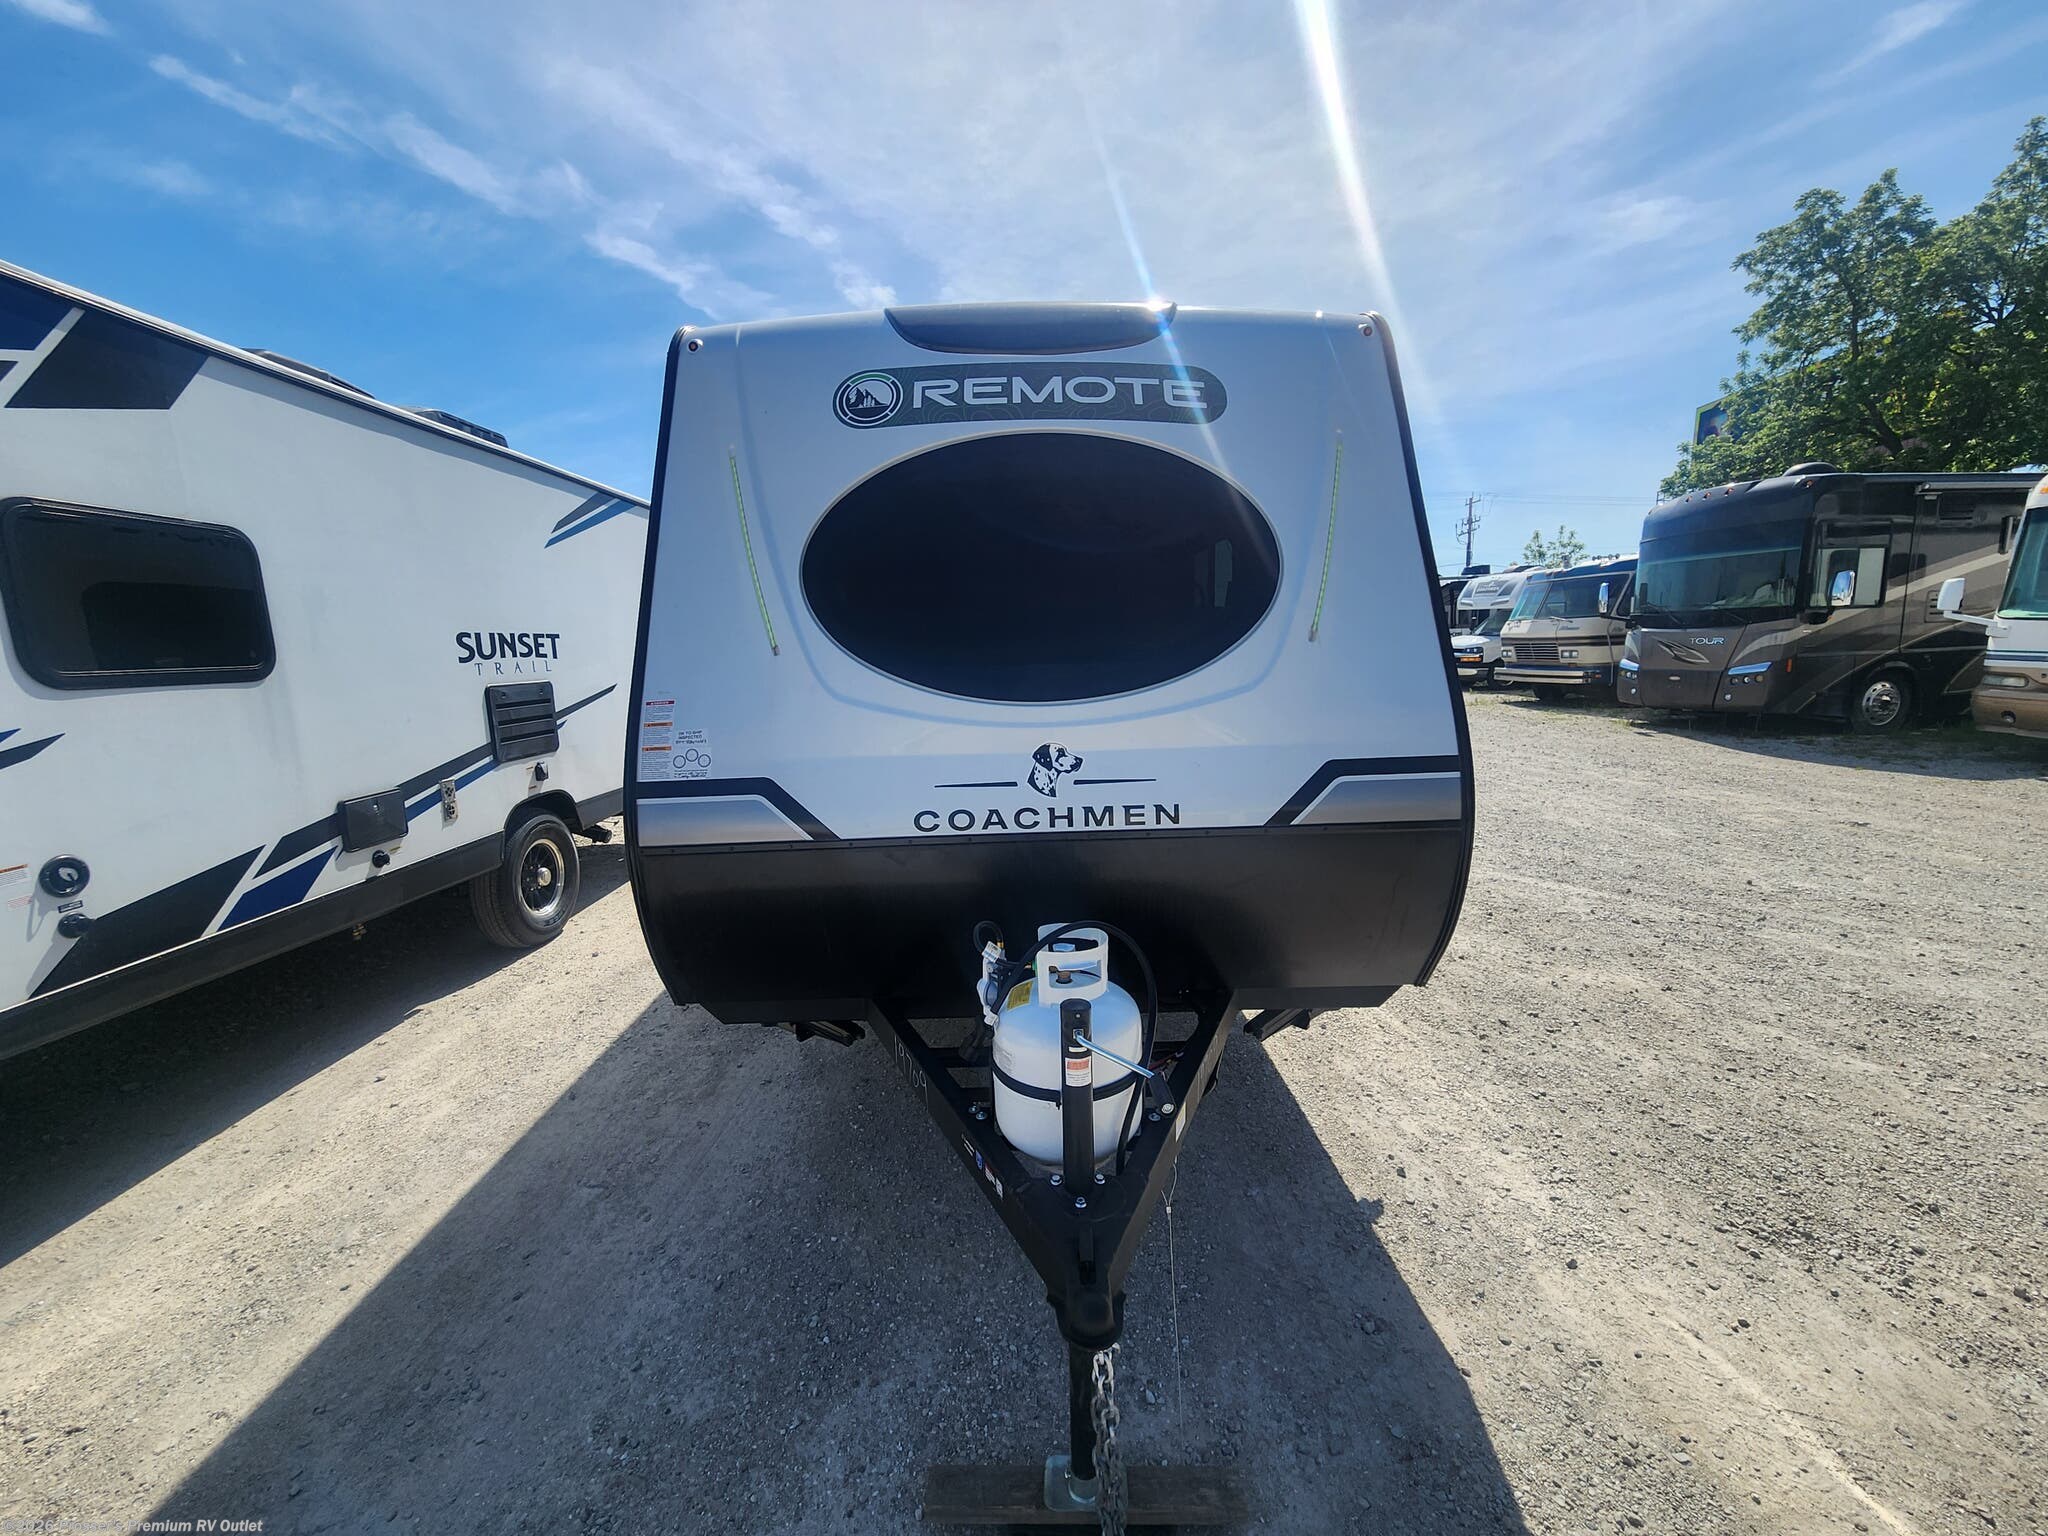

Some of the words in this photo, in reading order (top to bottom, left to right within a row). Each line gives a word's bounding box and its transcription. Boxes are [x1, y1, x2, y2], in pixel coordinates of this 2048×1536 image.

[913, 376, 1207, 409] REMOTE
[456, 631, 560, 664] SUNSET
[1689, 637, 1725, 645] TOUR
[474, 660, 552, 676] TRAIL
[913, 803, 1181, 833] COACHMEN
